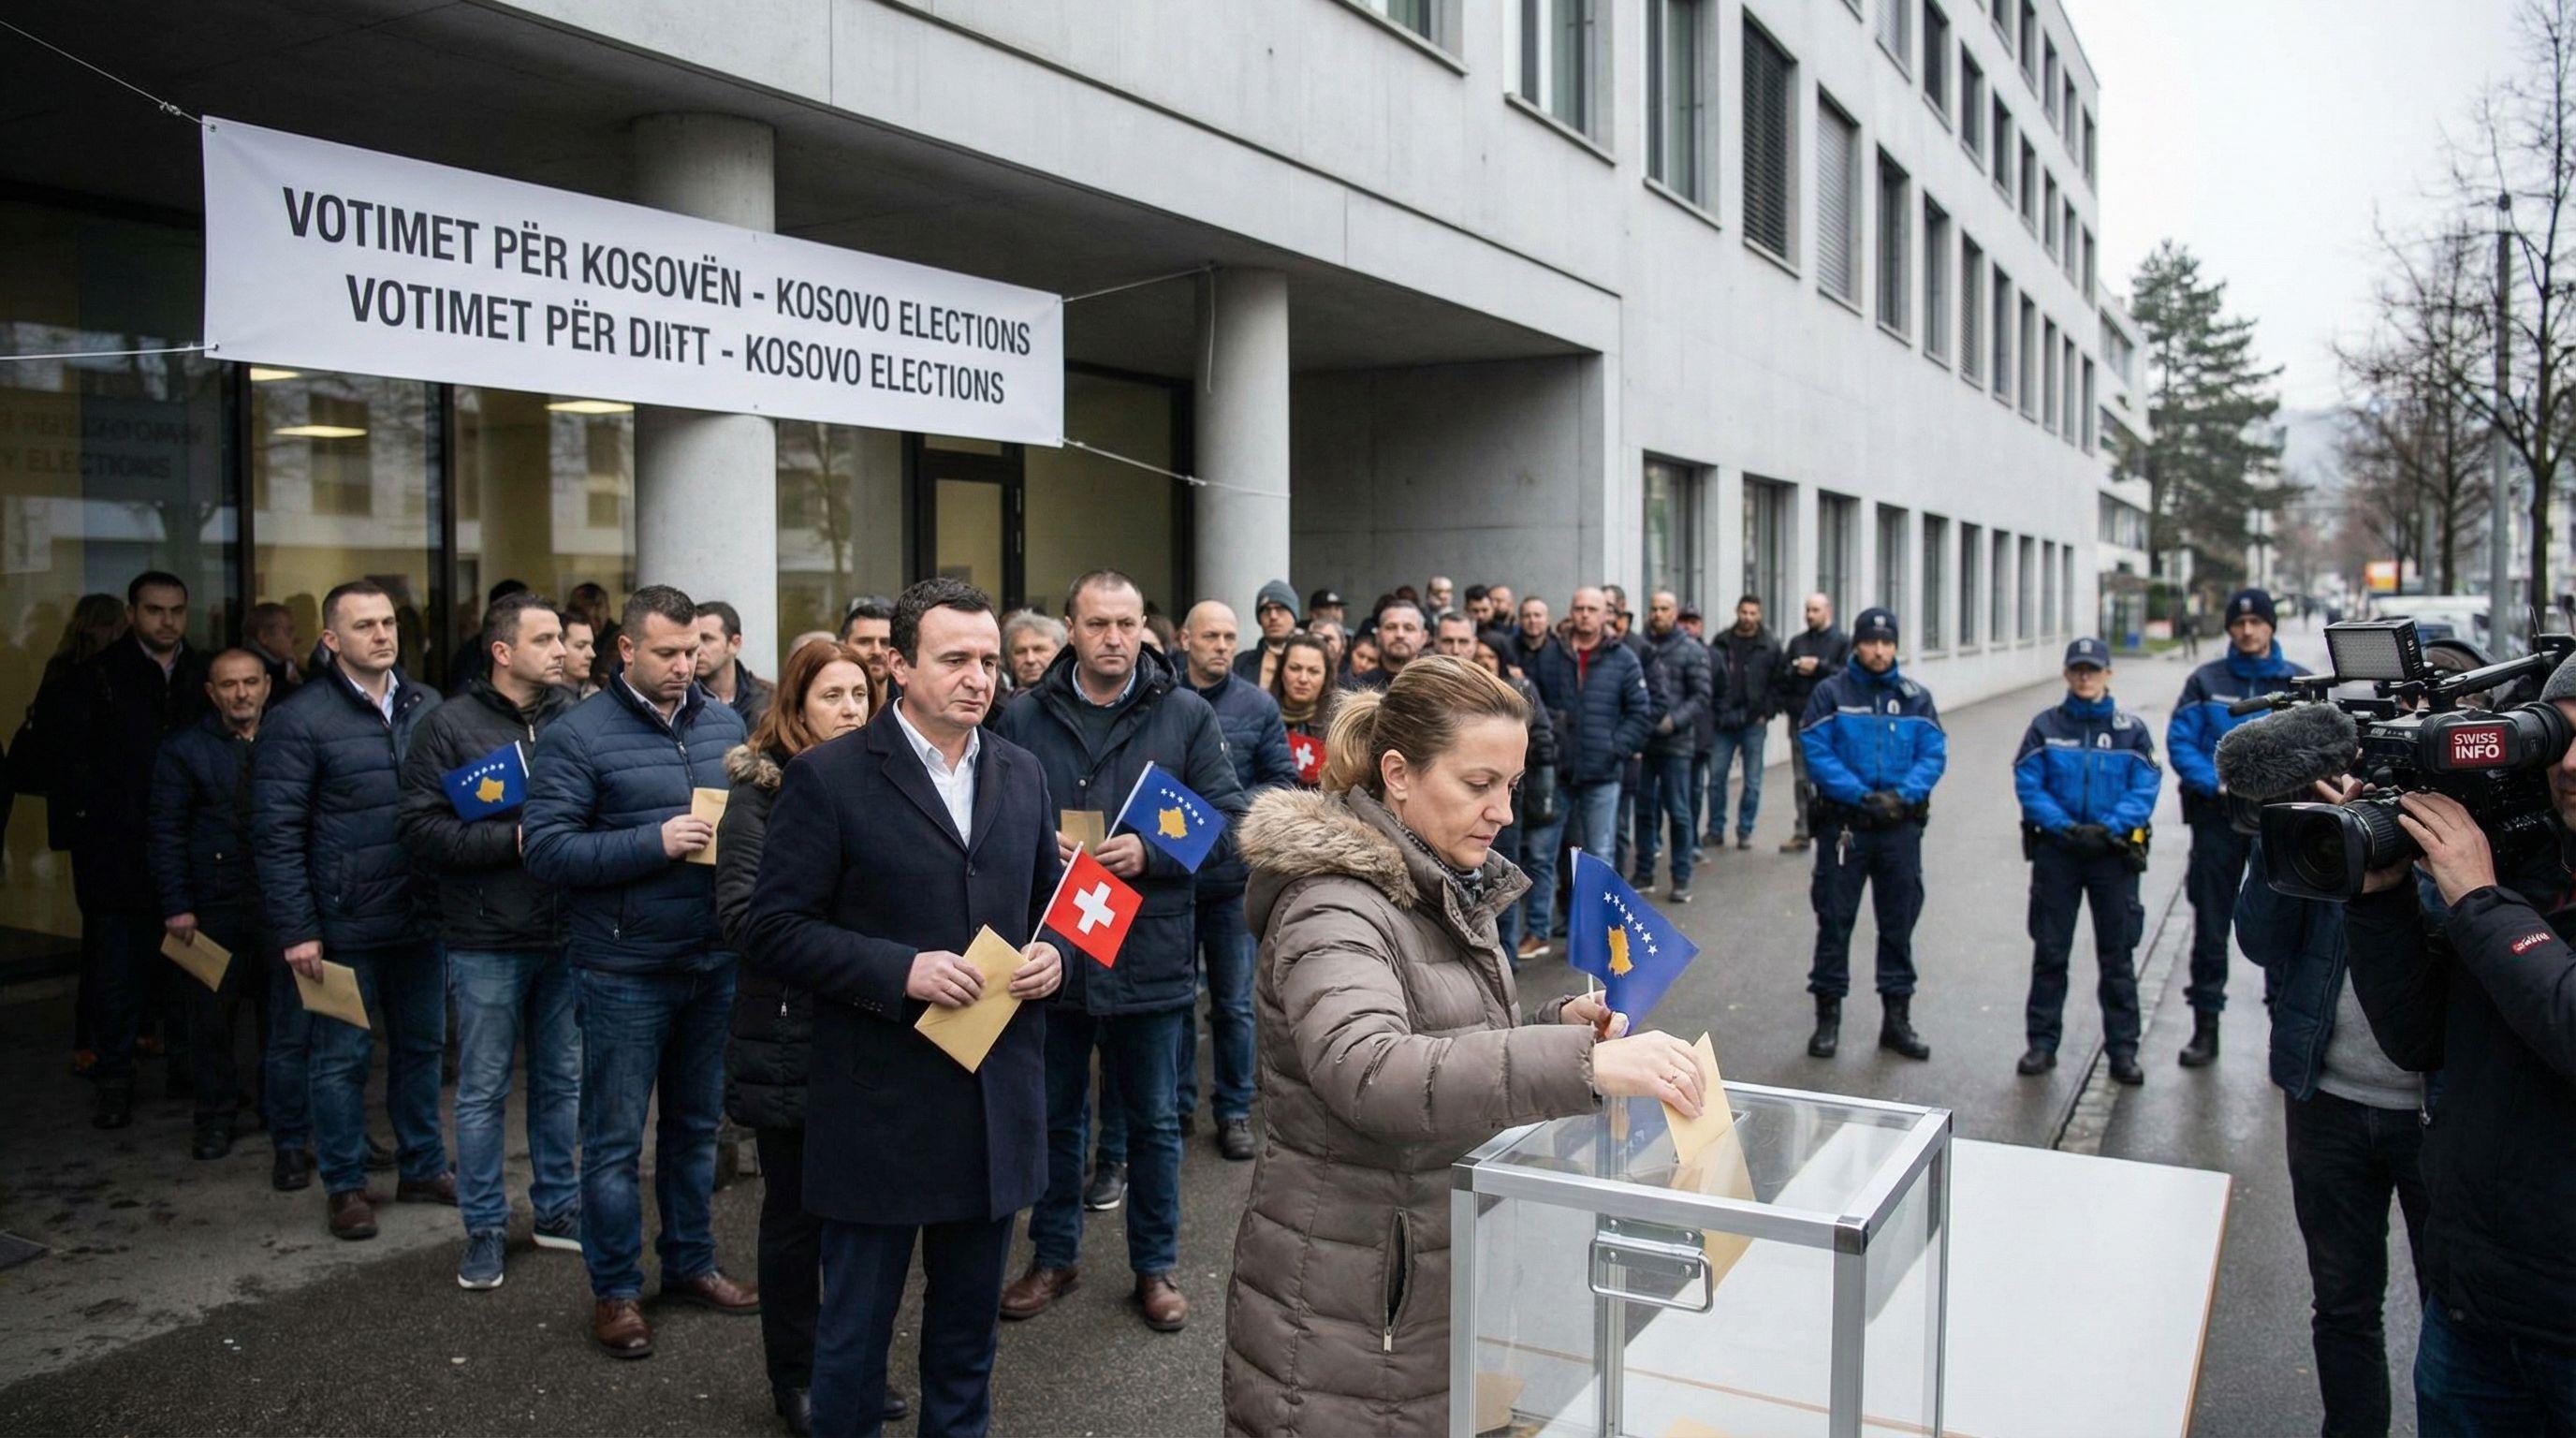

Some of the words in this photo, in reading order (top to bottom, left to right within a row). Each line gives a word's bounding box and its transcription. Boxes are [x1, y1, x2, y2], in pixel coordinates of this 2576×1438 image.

[283, 187, 480, 264] VOTIMET
[495, 221, 568, 280] PËR
[583, 242, 741, 308] KOSOVËN
[778, 278, 889, 331] KOSOVO
[900, 301, 1031, 356] ELECTIONS
[346, 274, 533, 343] VOTIMET
[548, 300, 616, 354] PËR
[747, 334, 861, 386] KOSOVO
[871, 354, 1004, 404] ELECTIONS
[2454, 732, 2497, 745] SWISS
[2455, 744, 2500, 759] INFO
